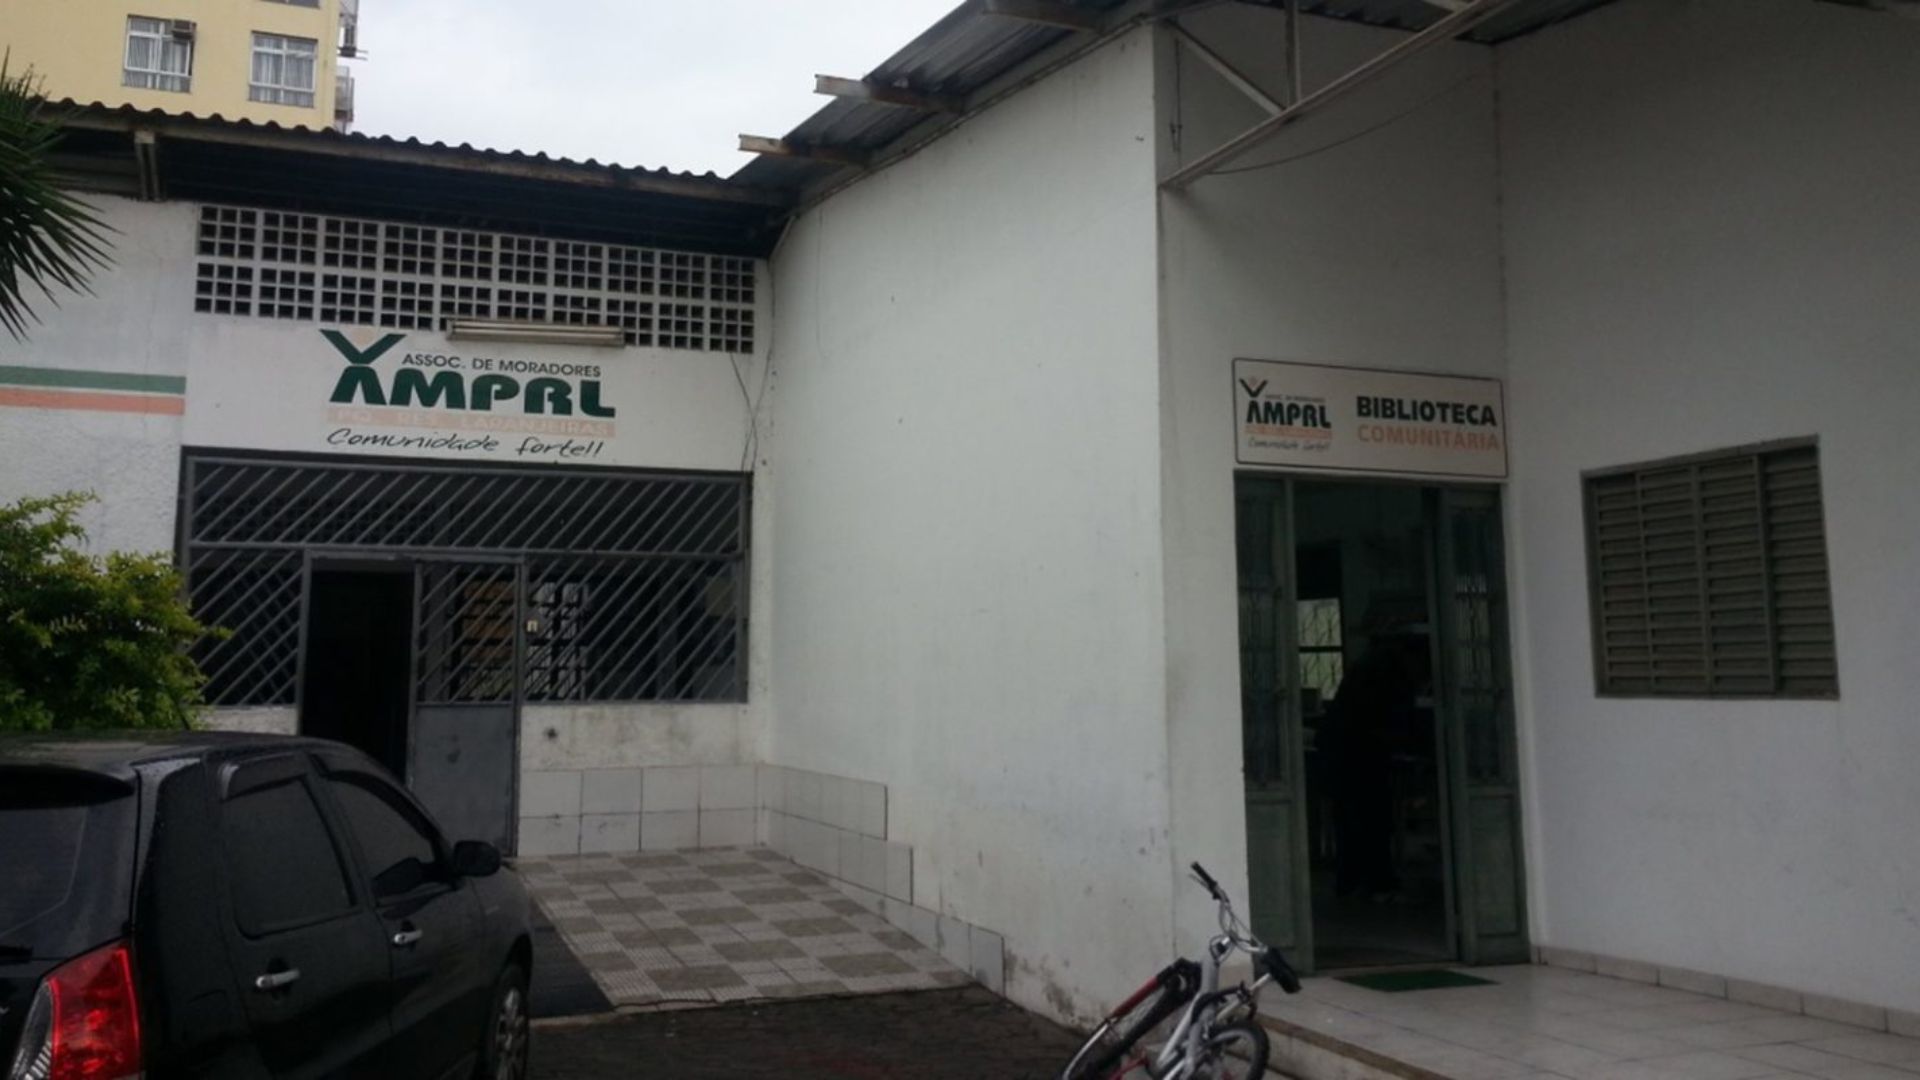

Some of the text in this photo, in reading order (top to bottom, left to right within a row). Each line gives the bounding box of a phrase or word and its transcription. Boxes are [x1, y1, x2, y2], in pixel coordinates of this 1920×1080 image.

[402, 352, 601, 378] ASSOC. DE MORADORES
[330, 365, 616, 418] AMPRL
[1247, 400, 1332, 429] AMPRL
[1356, 395, 1498, 427] BIBLIOTECA
[326, 428, 499, 451] Comunidade
